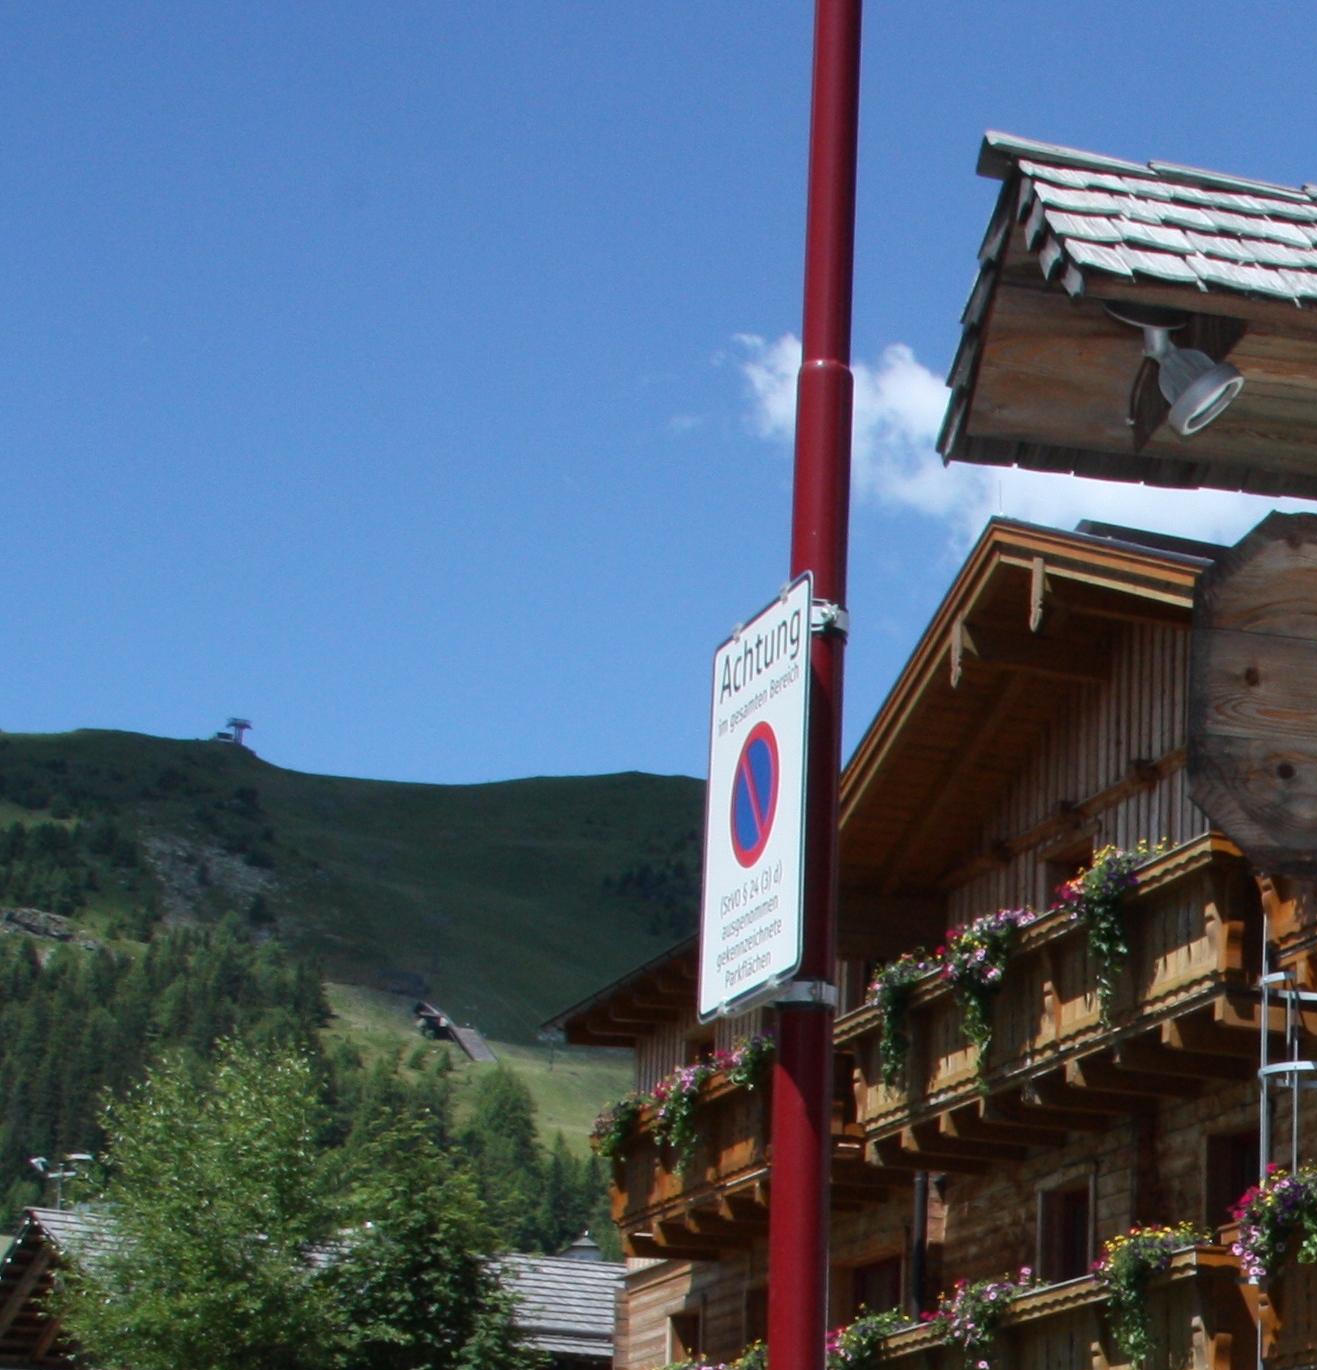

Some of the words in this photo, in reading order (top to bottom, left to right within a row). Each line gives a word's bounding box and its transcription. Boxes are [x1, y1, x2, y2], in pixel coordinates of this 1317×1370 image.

[720, 608, 801, 704] Achtung
[719, 719, 728, 737] im
[730, 689, 768, 733] gesamten
[769, 664, 800, 699] Bereich
[721, 895, 779, 941] ausgenommen
[716, 919, 783, 973] gekennzeichnete
[725, 951, 771, 988] Parkflächen
